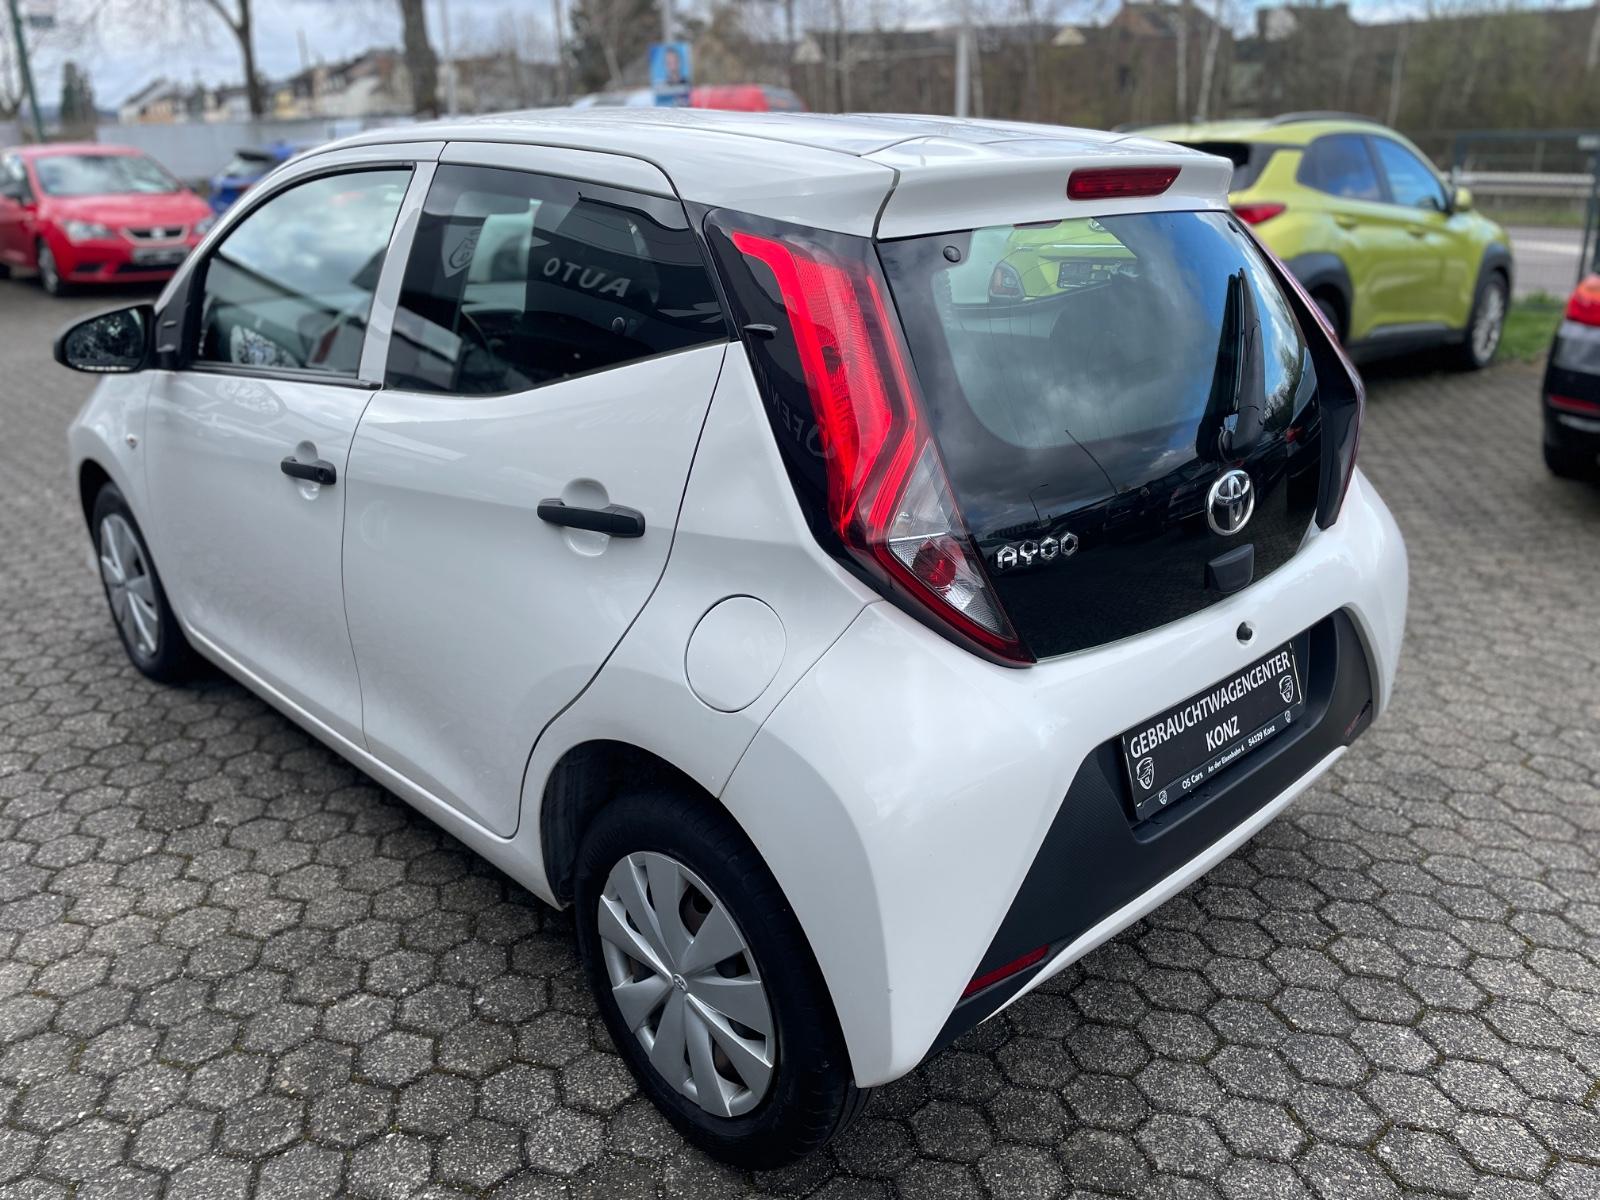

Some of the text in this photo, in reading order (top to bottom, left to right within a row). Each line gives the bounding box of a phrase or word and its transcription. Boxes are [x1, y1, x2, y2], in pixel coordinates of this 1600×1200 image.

[997, 531, 1079, 570] AYGO
[1130, 651, 1291, 758] GEBRAUCHTWAGENCENTER
[1191, 772, 1203, 783] Cars
[1208, 765, 1214, 773] An
[1248, 731, 1263, 747] 54329
[1263, 725, 1275, 737] Konz
[1205, 715, 1240, 751] KONZ
